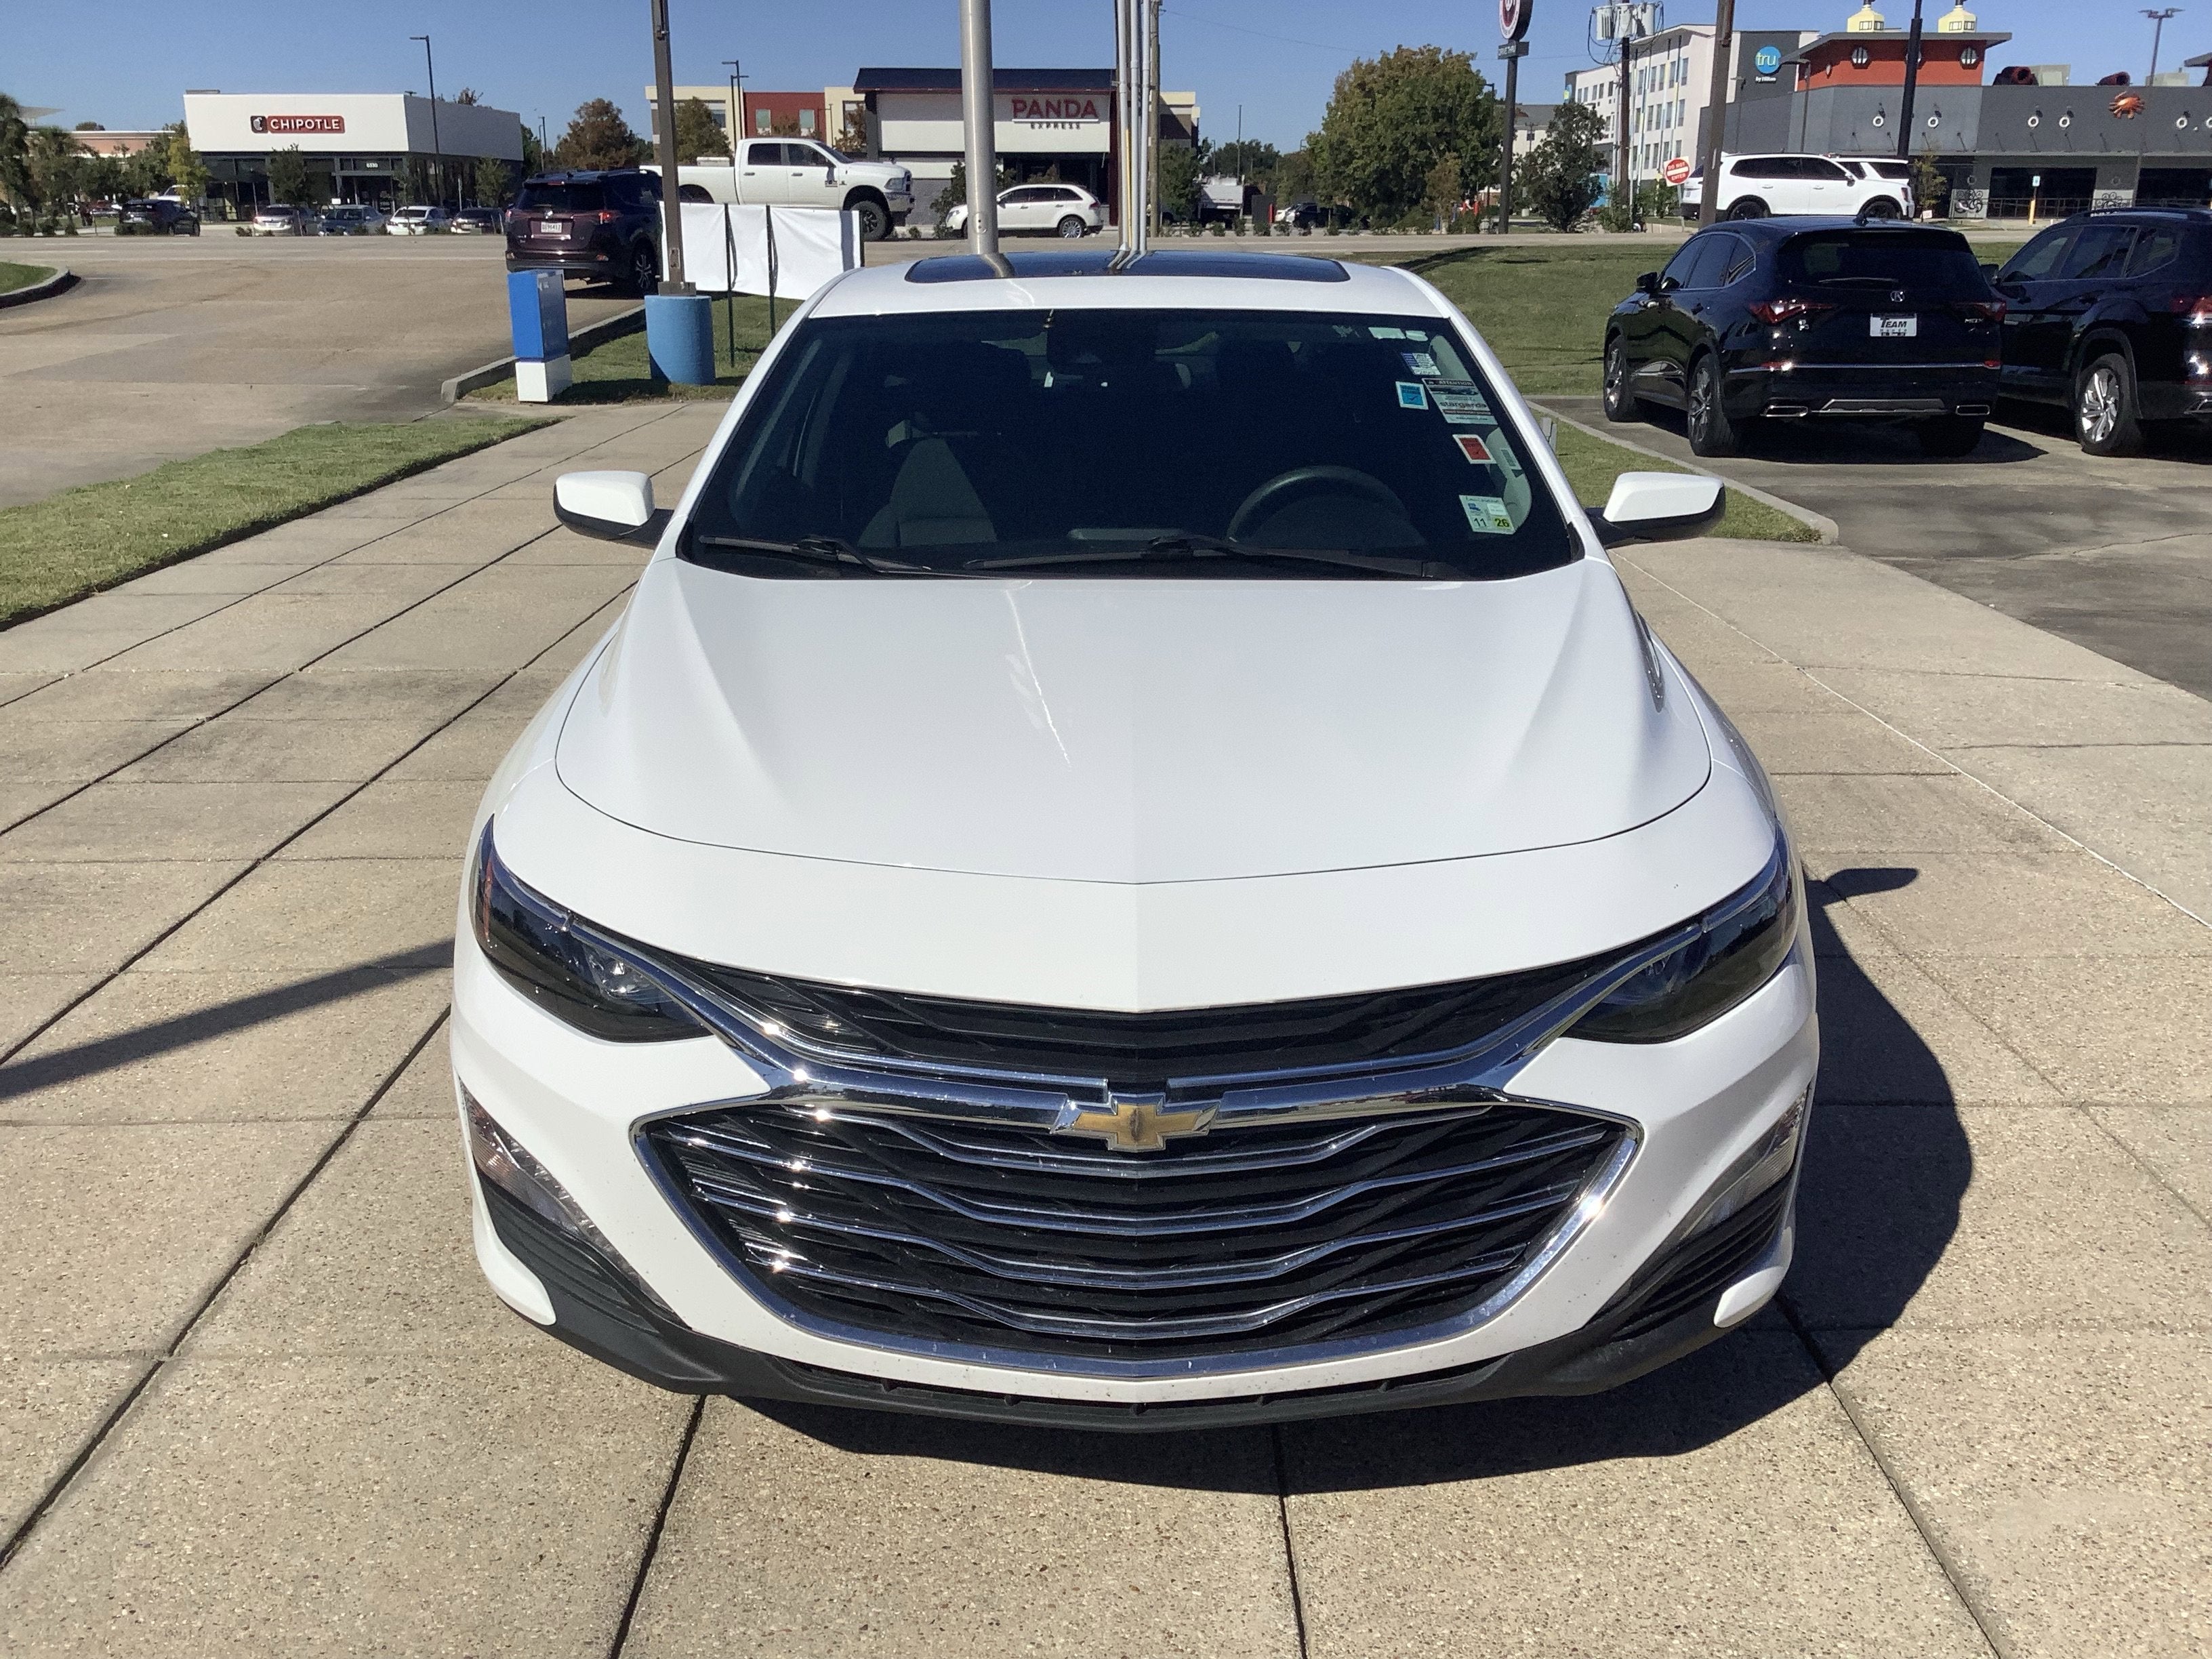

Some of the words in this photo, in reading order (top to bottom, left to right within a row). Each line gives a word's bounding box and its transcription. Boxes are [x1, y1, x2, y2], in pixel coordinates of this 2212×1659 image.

[1756, 52, 1776, 66] tru
[1012, 99, 1098, 119] PANDA
[270, 119, 340, 129] CHIPOTLE
[1671, 173, 1686, 181] ENTER
[1880, 317, 1907, 328] TEAM
[1474, 518, 1487, 527] 11
[1494, 518, 1510, 527] 26
